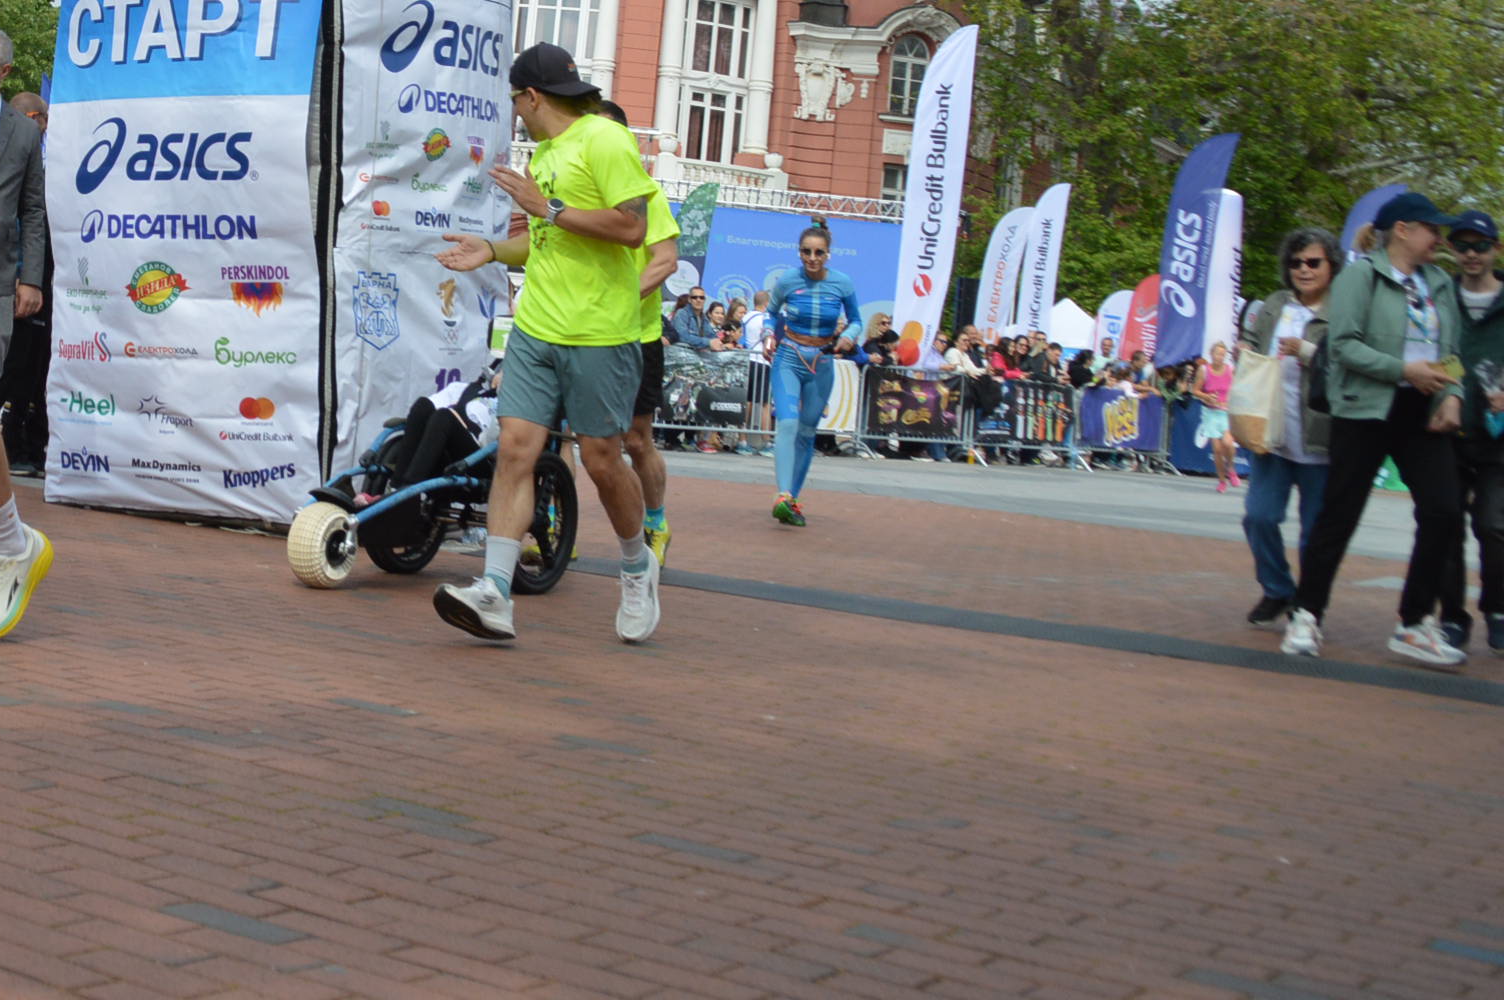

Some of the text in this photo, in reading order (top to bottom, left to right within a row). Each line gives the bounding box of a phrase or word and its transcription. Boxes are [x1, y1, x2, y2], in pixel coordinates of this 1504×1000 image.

[424, 89, 500, 123] DECATHLON
[917, 82, 954, 271] UniCredit Bulbank
[107, 214, 258, 241] DECATHLON
[415, 211, 451, 229] DEVIN
[1035, 218, 1054, 272] Bulbank
[221, 265, 290, 281] PERSKINDOL
[59, 338, 95, 361] SupraVit
[160, 413, 194, 428] Fraport
[60, 451, 111, 473] DEVIN
[131, 459, 202, 472] MaxDynamics
[223, 463, 296, 489] Knoppers
